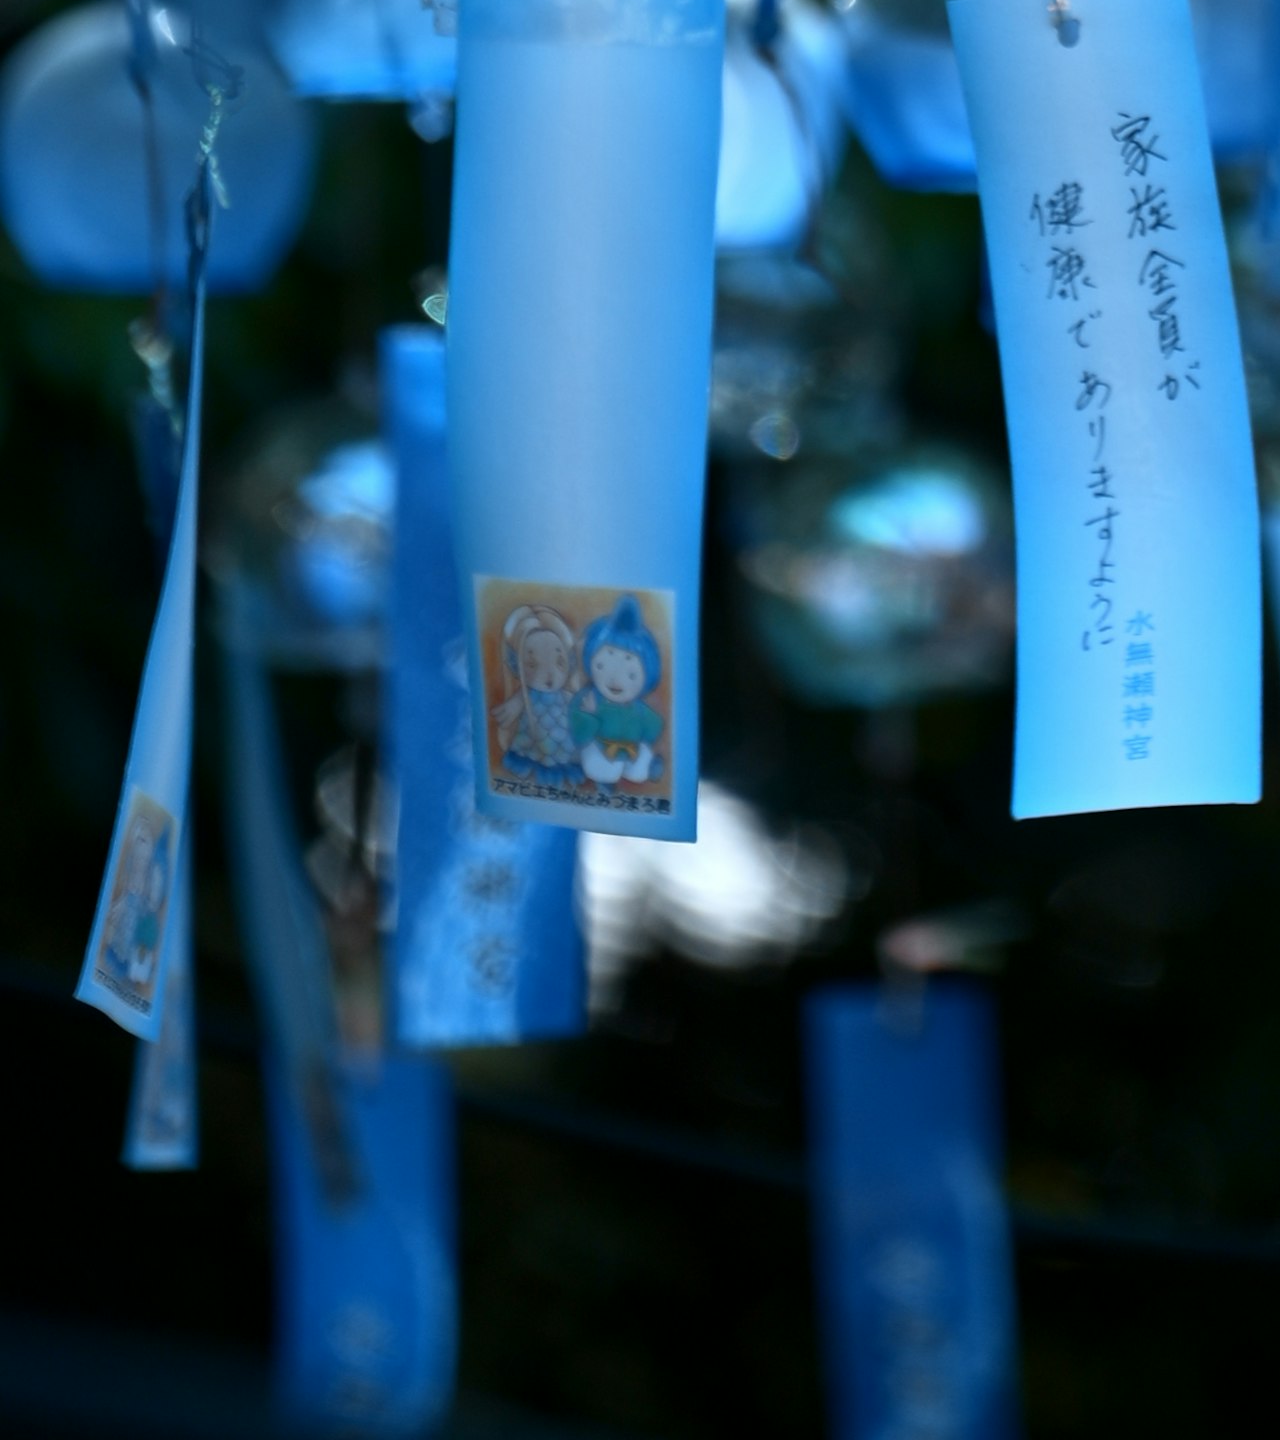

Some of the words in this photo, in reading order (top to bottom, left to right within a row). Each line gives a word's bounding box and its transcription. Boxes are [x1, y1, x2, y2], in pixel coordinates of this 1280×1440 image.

[1110, 111, 1203, 402] 家族全員が
[1029, 181, 1120, 652] 健康でありますように
[1121, 609, 1156, 761] 水無瀬神宮
